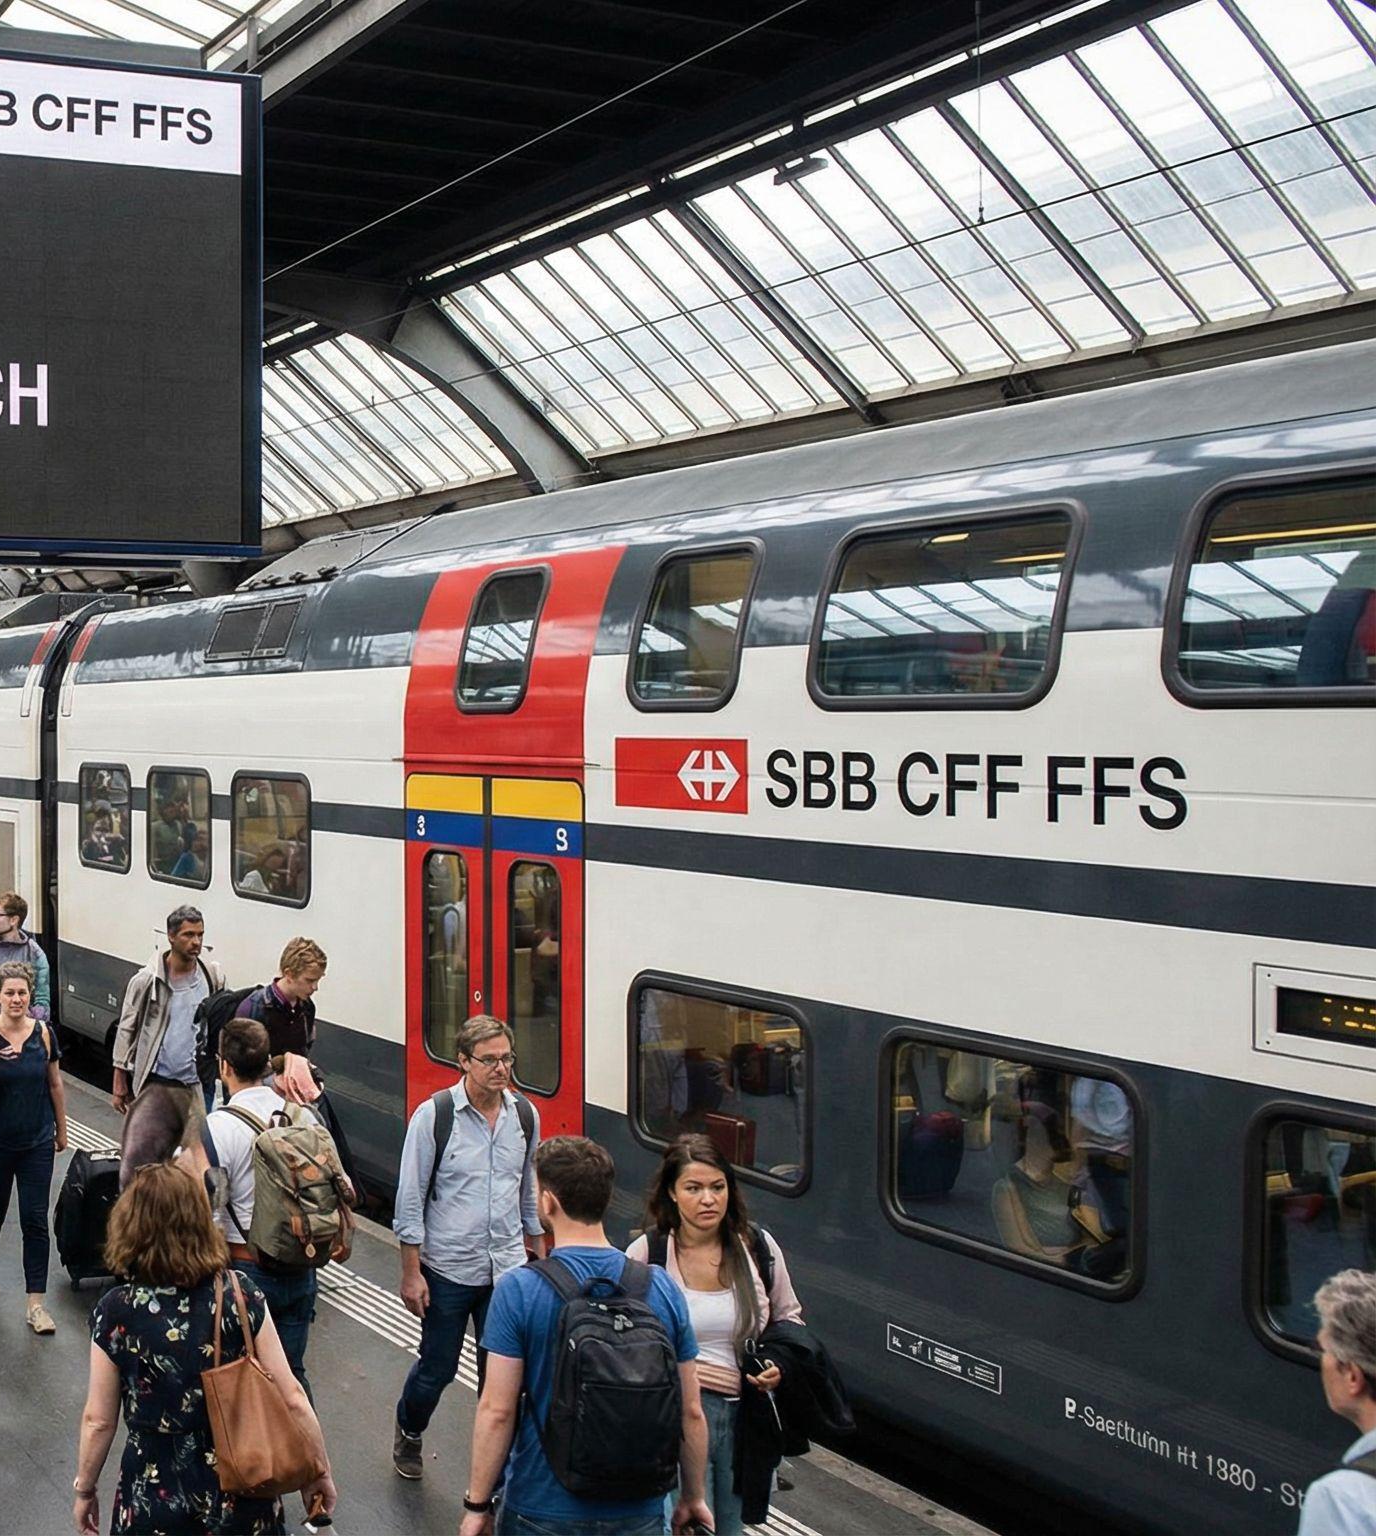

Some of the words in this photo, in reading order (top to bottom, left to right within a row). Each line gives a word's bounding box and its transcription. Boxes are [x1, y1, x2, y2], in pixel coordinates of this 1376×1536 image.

[32, 93, 119, 136] CFF
[133, 103, 213, 145] FFS
[765, 748, 877, 811] SBB
[897, 751, 1023, 819] CFF
[1047, 755, 1188, 831] FFS
